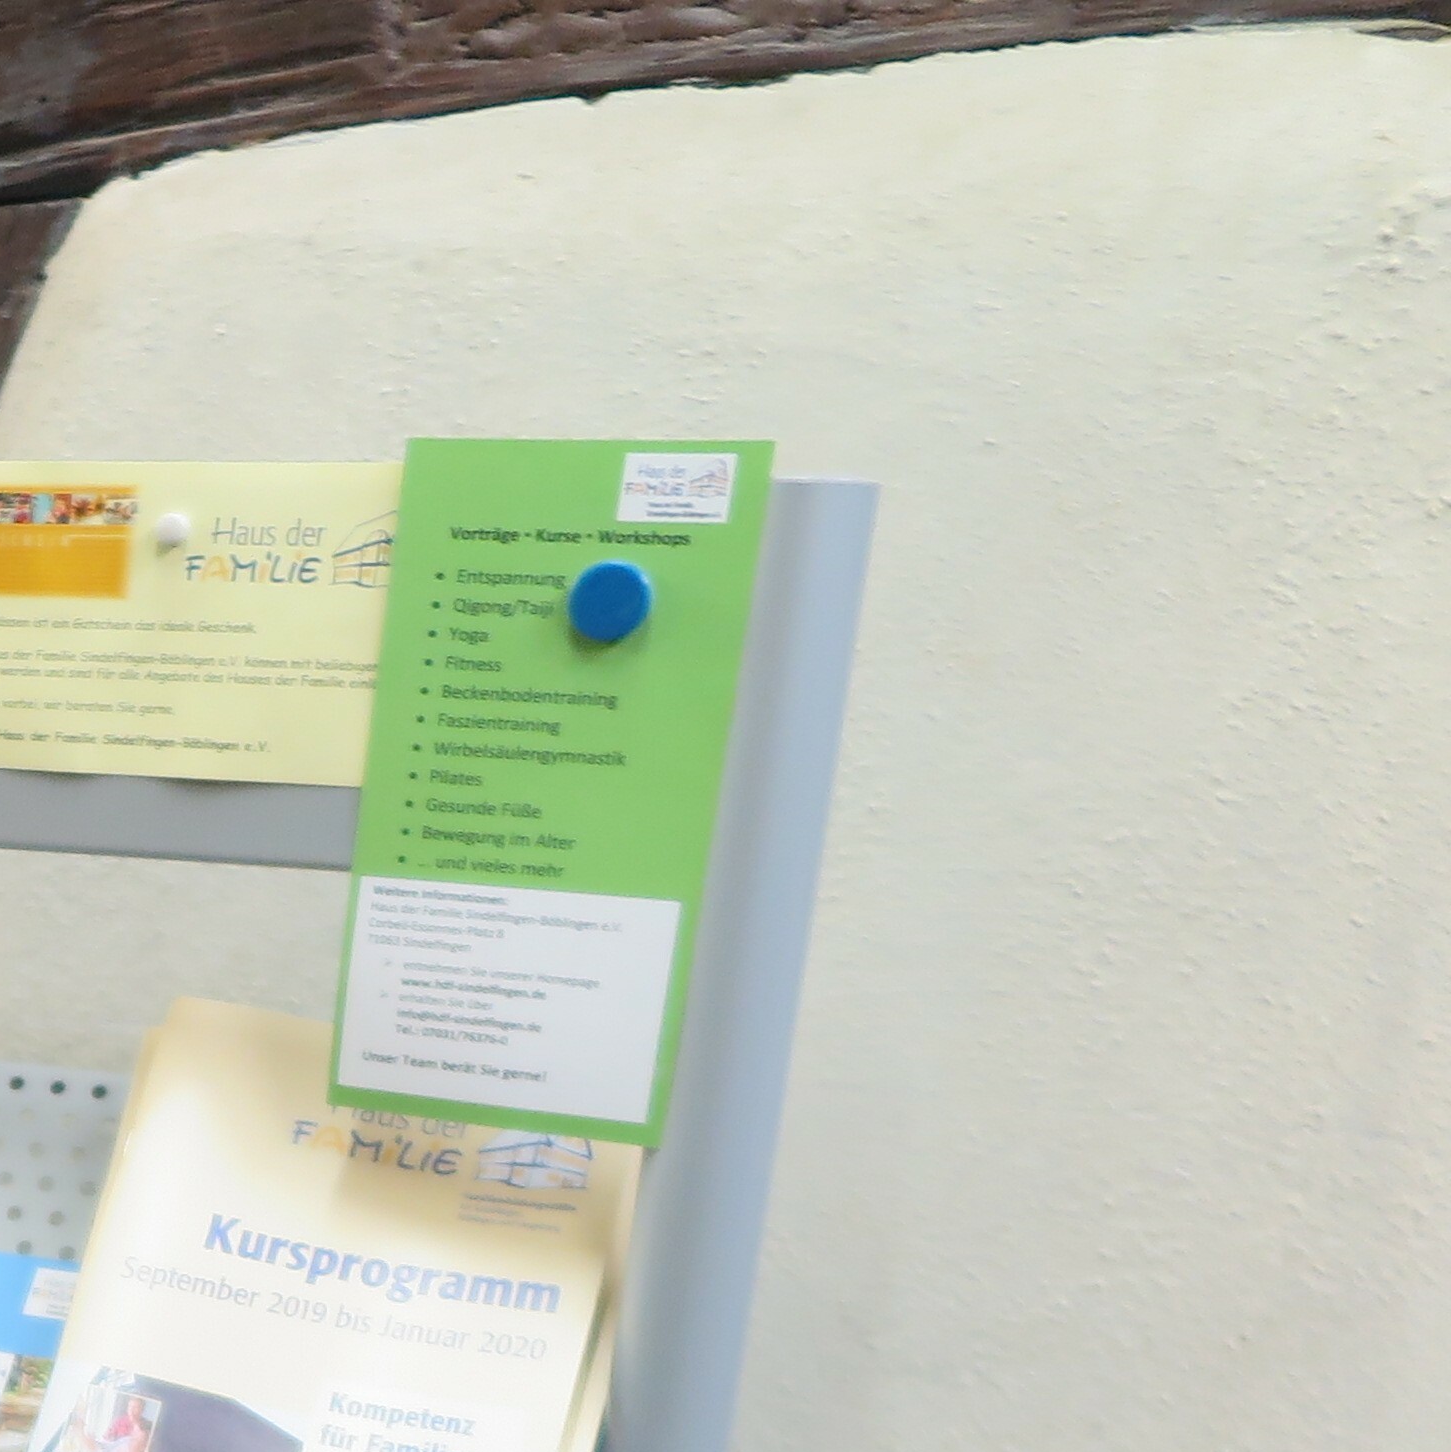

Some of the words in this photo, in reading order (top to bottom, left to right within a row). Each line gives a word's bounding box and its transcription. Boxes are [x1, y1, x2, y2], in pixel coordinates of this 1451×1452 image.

[211, 517, 277, 546] Haus
[286, 517, 327, 547] der
[450, 526, 520, 544] Vorträge
[535, 528, 582, 544] Kurse
[597, 529, 692, 547] Workshops
[457, 569, 566, 589] Entspannung
[449, 627, 490, 645] Yoga
[445, 656, 502, 672] Fitness
[441, 684, 618, 710] Beckenbodentraining
[437, 713, 561, 736] Faszientraining
[434, 742, 627, 766] Wirbelsäulengymnastik
[430, 769, 482, 786] Pilates
[426, 798, 496, 816] Gesunde
[501, 803, 542, 819] Füße
[422, 825, 505, 848] Bewegung
[509, 832, 530, 846] im
[536, 834, 575, 850] Alter
[436, 857, 467, 870] und
[470, 860, 516, 875] vieles
[520, 863, 564, 878] mehr
[401, 1054, 438, 1069] Team
[203, 1212, 561, 1313] Kursprogramm
[119, 1255, 260, 1308] September
[266, 1291, 328, 1324] 2019
[334, 1303, 370, 1335] bis
[378, 1314, 471, 1352] Januar
[477, 1331, 547, 1361] 2020
[327, 1391, 477, 1437] Kompetenz
[319, 1423, 358, 1451] für
